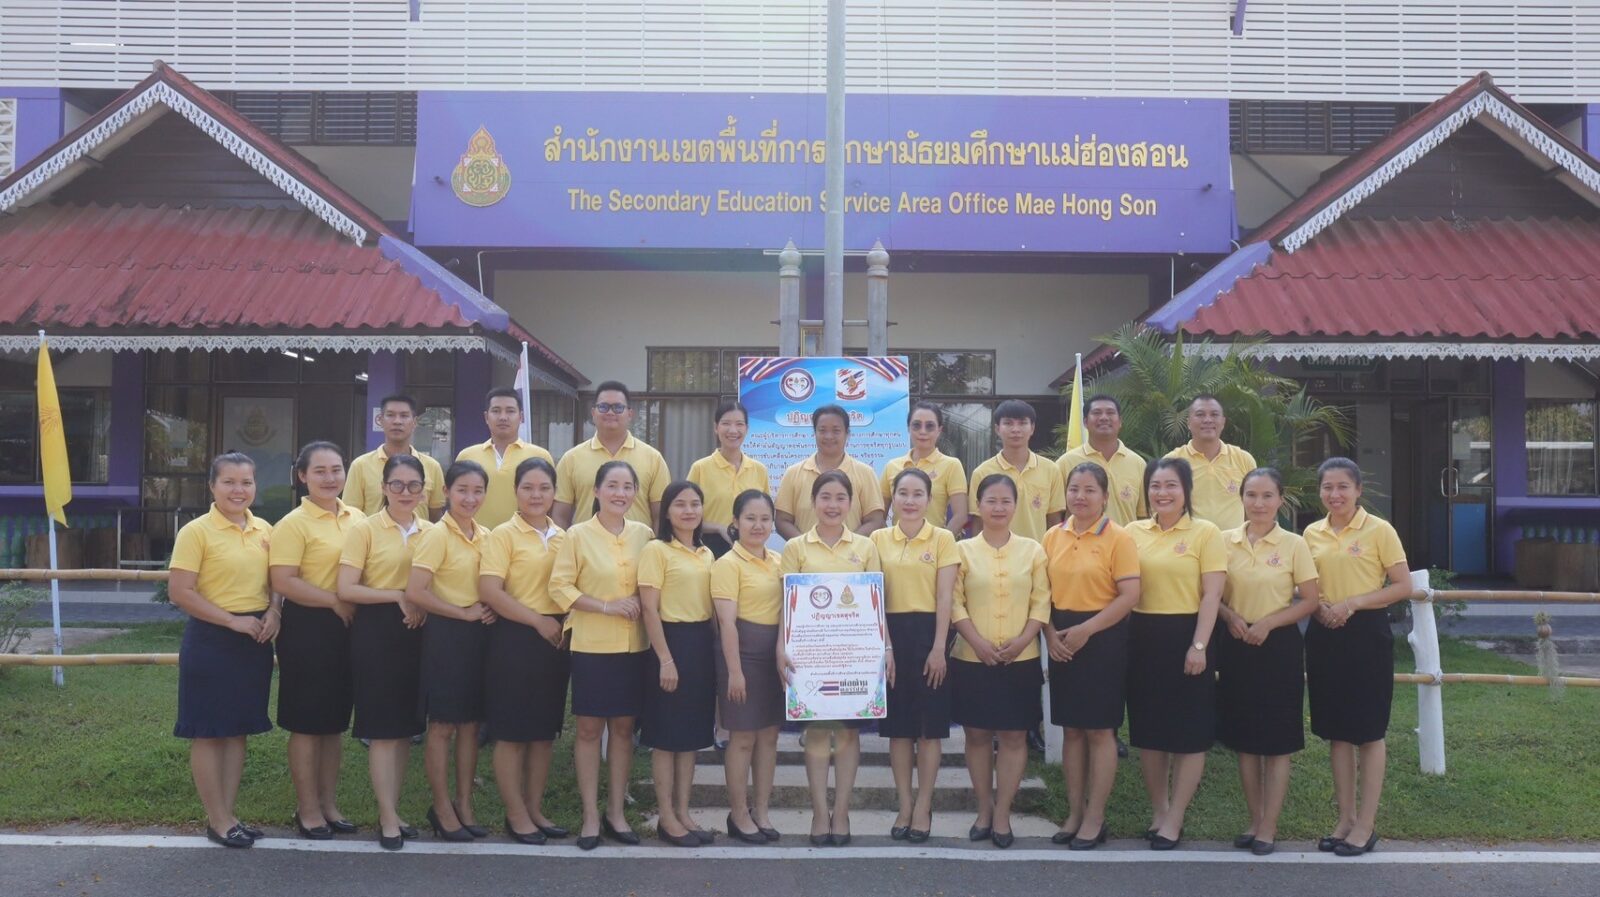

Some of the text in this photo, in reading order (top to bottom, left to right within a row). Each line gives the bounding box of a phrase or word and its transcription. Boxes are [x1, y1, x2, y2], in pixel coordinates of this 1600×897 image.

[544, 114, 1188, 168] สำนักงานเขตพื้นที่การกษามัธยมศึกษาแม่ฮ่องสอน
[568, 189, 1157, 221] The Secondary Education rvice Area Office Mae Hong Son
